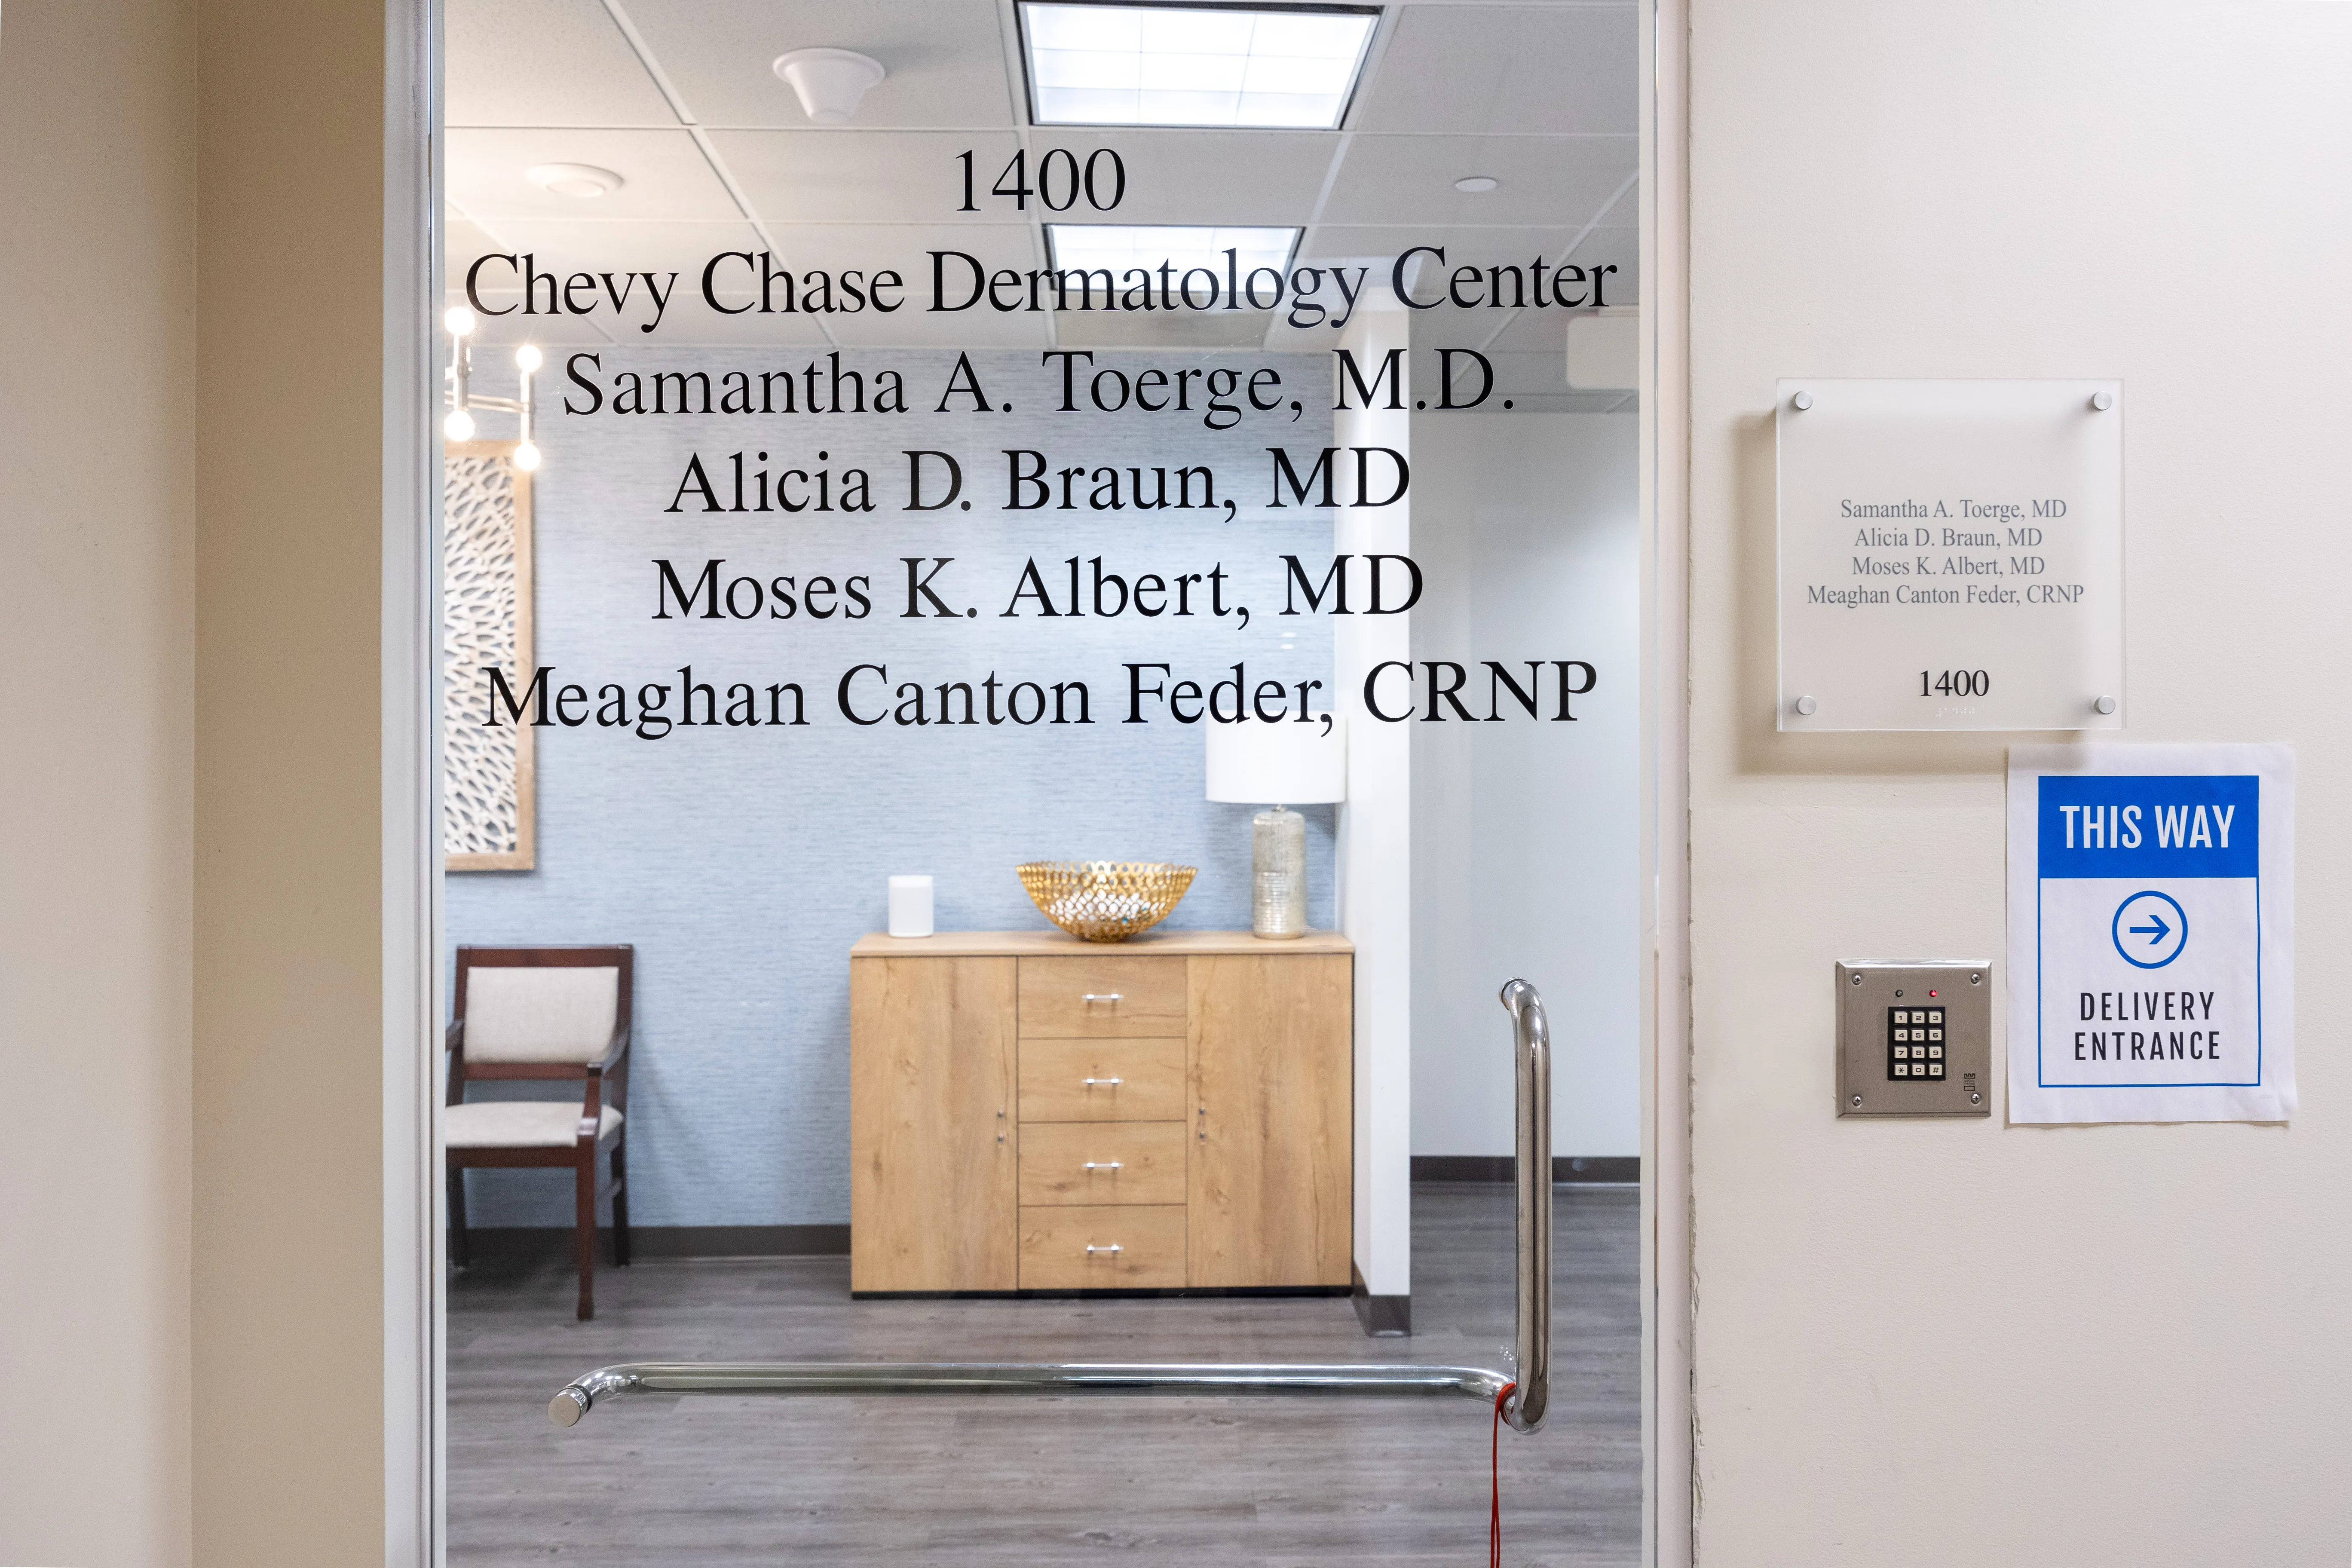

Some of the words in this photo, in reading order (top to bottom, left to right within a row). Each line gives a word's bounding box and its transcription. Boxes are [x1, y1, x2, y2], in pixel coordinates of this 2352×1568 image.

[956, 149, 1125, 211] 1400
[467, 254, 679, 333] Chevy
[702, 251, 904, 314] Chase
[926, 248, 1369, 328] Dermatology
[1393, 247, 1617, 309] Center
[564, 351, 909, 415] Samantha
[934, 351, 1012, 412] A.
[1042, 351, 1302, 430] Toerge,
[1332, 349, 1513, 410] M.D.
[664, 451, 876, 512] Alicia
[902, 451, 971, 511] D.
[1002, 450, 1236, 523] Braun,
[1266, 448, 1409, 507] MD
[1842, 499, 1928, 518] Samantha
[1933, 500, 1953, 518] A.
[1960, 500, 2024, 523] Toerge,
[2032, 500, 2066, 517] MD
[1854, 528, 1908, 546] Alicia
[1915, 529, 1934, 546] D.
[1942, 528, 2000, 550] Braun,
[2008, 528, 2042, 546] MD
[1852, 557, 1909, 575] Moses
[1916, 557, 1936, 575] K.
[1942, 556, 2003, 578] Albert,
[2010, 557, 2044, 574] MD
[652, 560, 870, 619] Moses
[900, 558, 977, 618] K.
[999, 556, 1249, 630] Albert,
[1279, 555, 1422, 615] MD
[1808, 585, 1890, 609] Meaghan
[1896, 585, 1960, 603] Canton
[1966, 585, 2020, 606] Feder,
[2027, 585, 2083, 603] CRNP
[1920, 670, 1989, 696] 1400
[482, 665, 810, 740] Meaghan
[838, 665, 1095, 726] Canton
[1122, 662, 1332, 737] Feder,
[1364, 662, 1596, 722] CRNP
[2060, 805, 2141, 848] THIS
[2155, 805, 2235, 848] WAY
[2081, 992, 2214, 1020] DELIVERY
[2075, 1032, 2219, 1060] ENTRANCE
